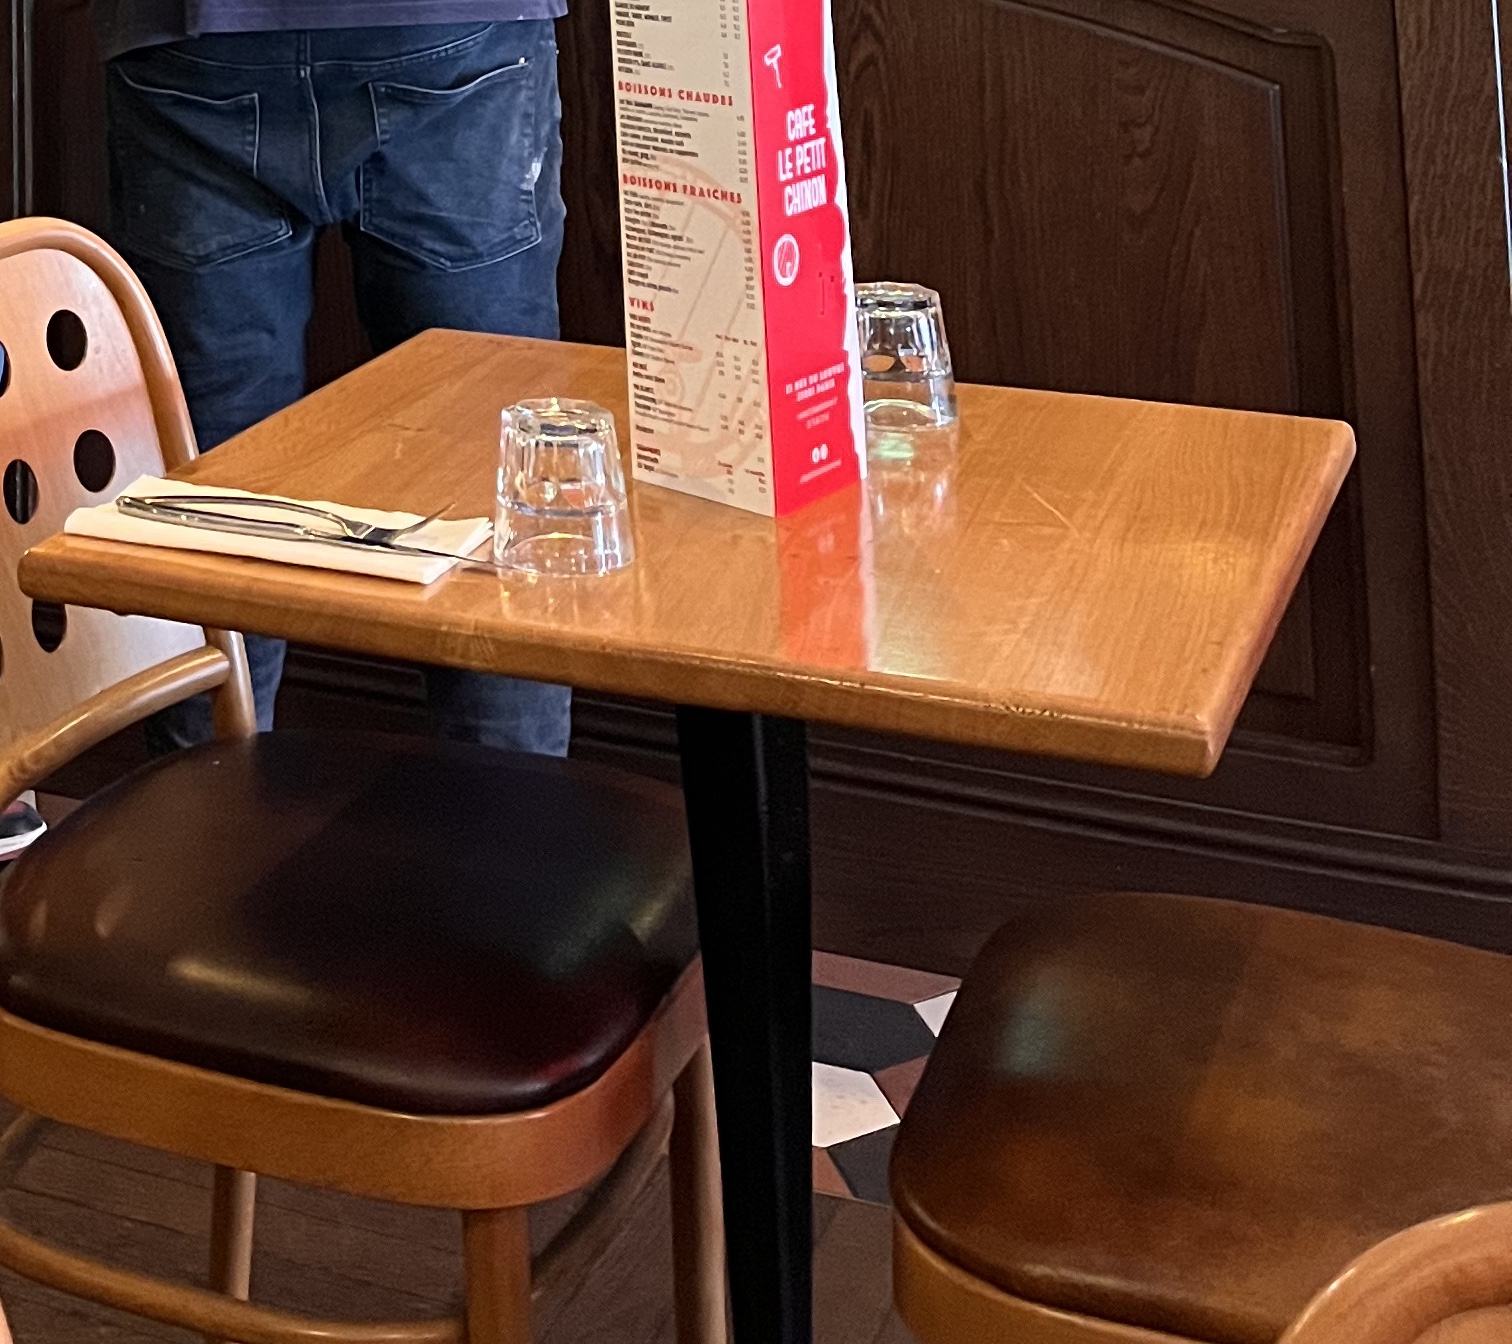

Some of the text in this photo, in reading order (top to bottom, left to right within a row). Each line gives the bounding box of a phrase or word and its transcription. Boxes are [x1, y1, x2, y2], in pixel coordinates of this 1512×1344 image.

[618, 80, 733, 107] BOISSONS CHAUDES
[777, 147, 793, 182] LE
[795, 137, 826, 176] PETIT
[622, 173, 677, 193] BOISSONS
[784, 174, 827, 217] CHINON
[628, 296, 655, 312] VINS
